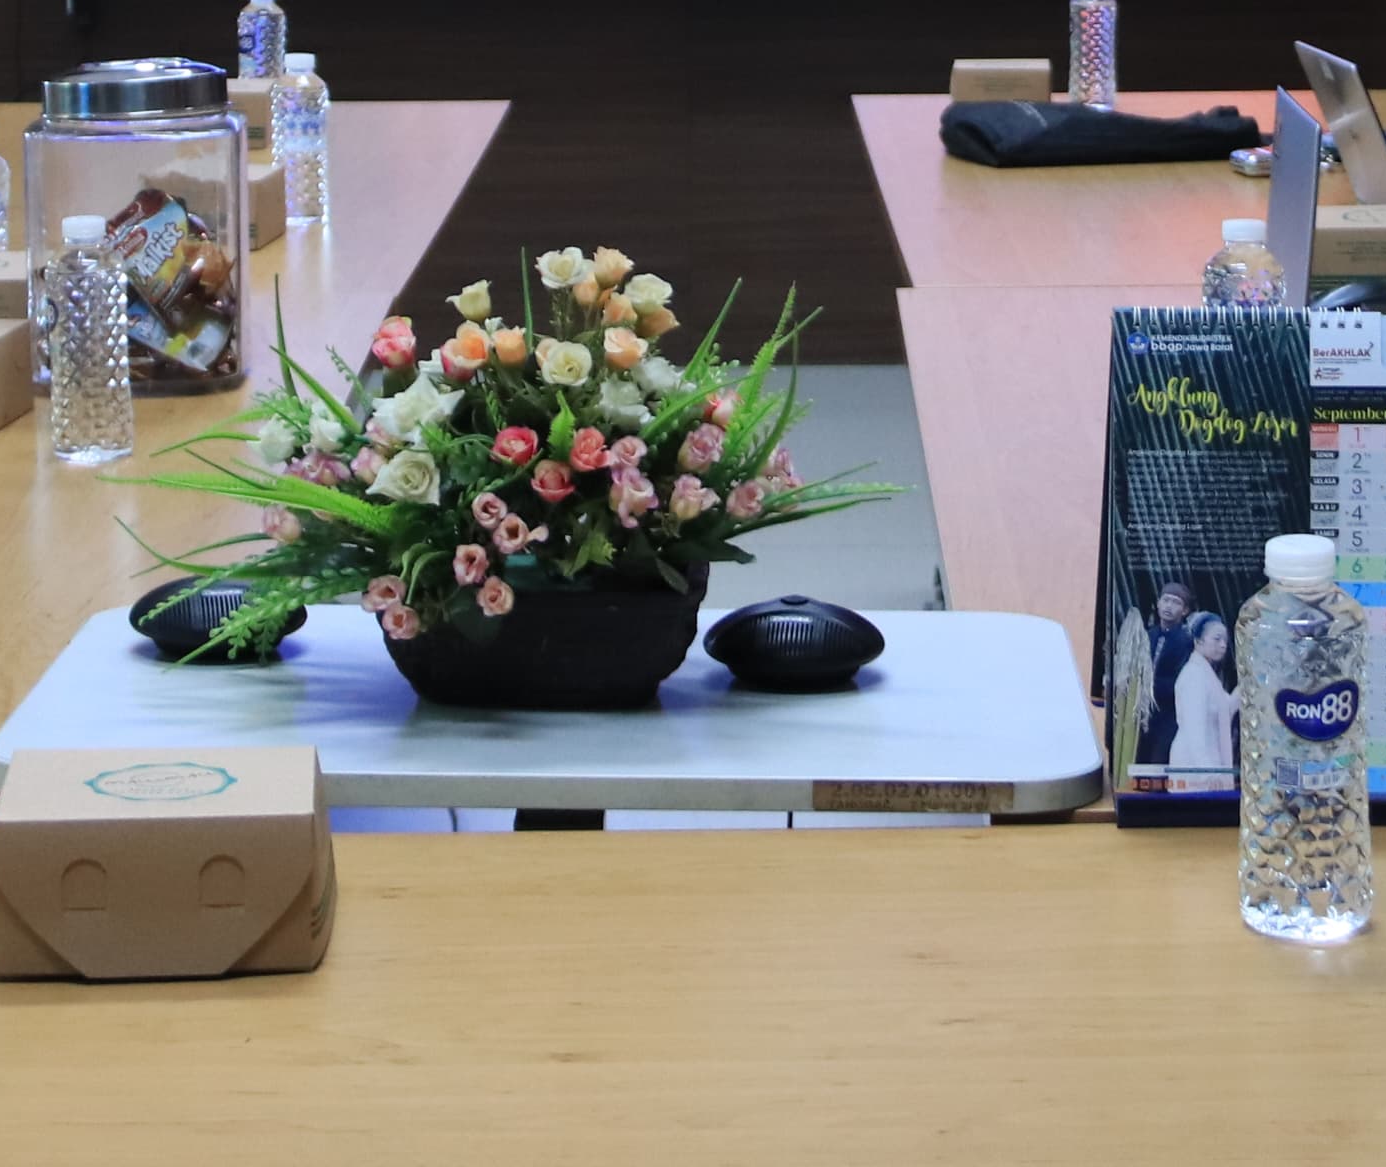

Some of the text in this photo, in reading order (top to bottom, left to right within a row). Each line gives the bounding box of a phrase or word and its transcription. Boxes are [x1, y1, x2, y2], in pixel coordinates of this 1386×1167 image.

[1313, 347, 1371, 357] BerAKHLAK
[1354, 427, 1361, 442] 1
[1351, 453, 1362, 469] 2
[1351, 479, 1362, 494] 3
[1351, 505, 1362, 520] 4
[1351, 531, 1363, 547] 5
[1351, 558, 1362, 573] 6
[1286, 689, 1352, 725] RON88
